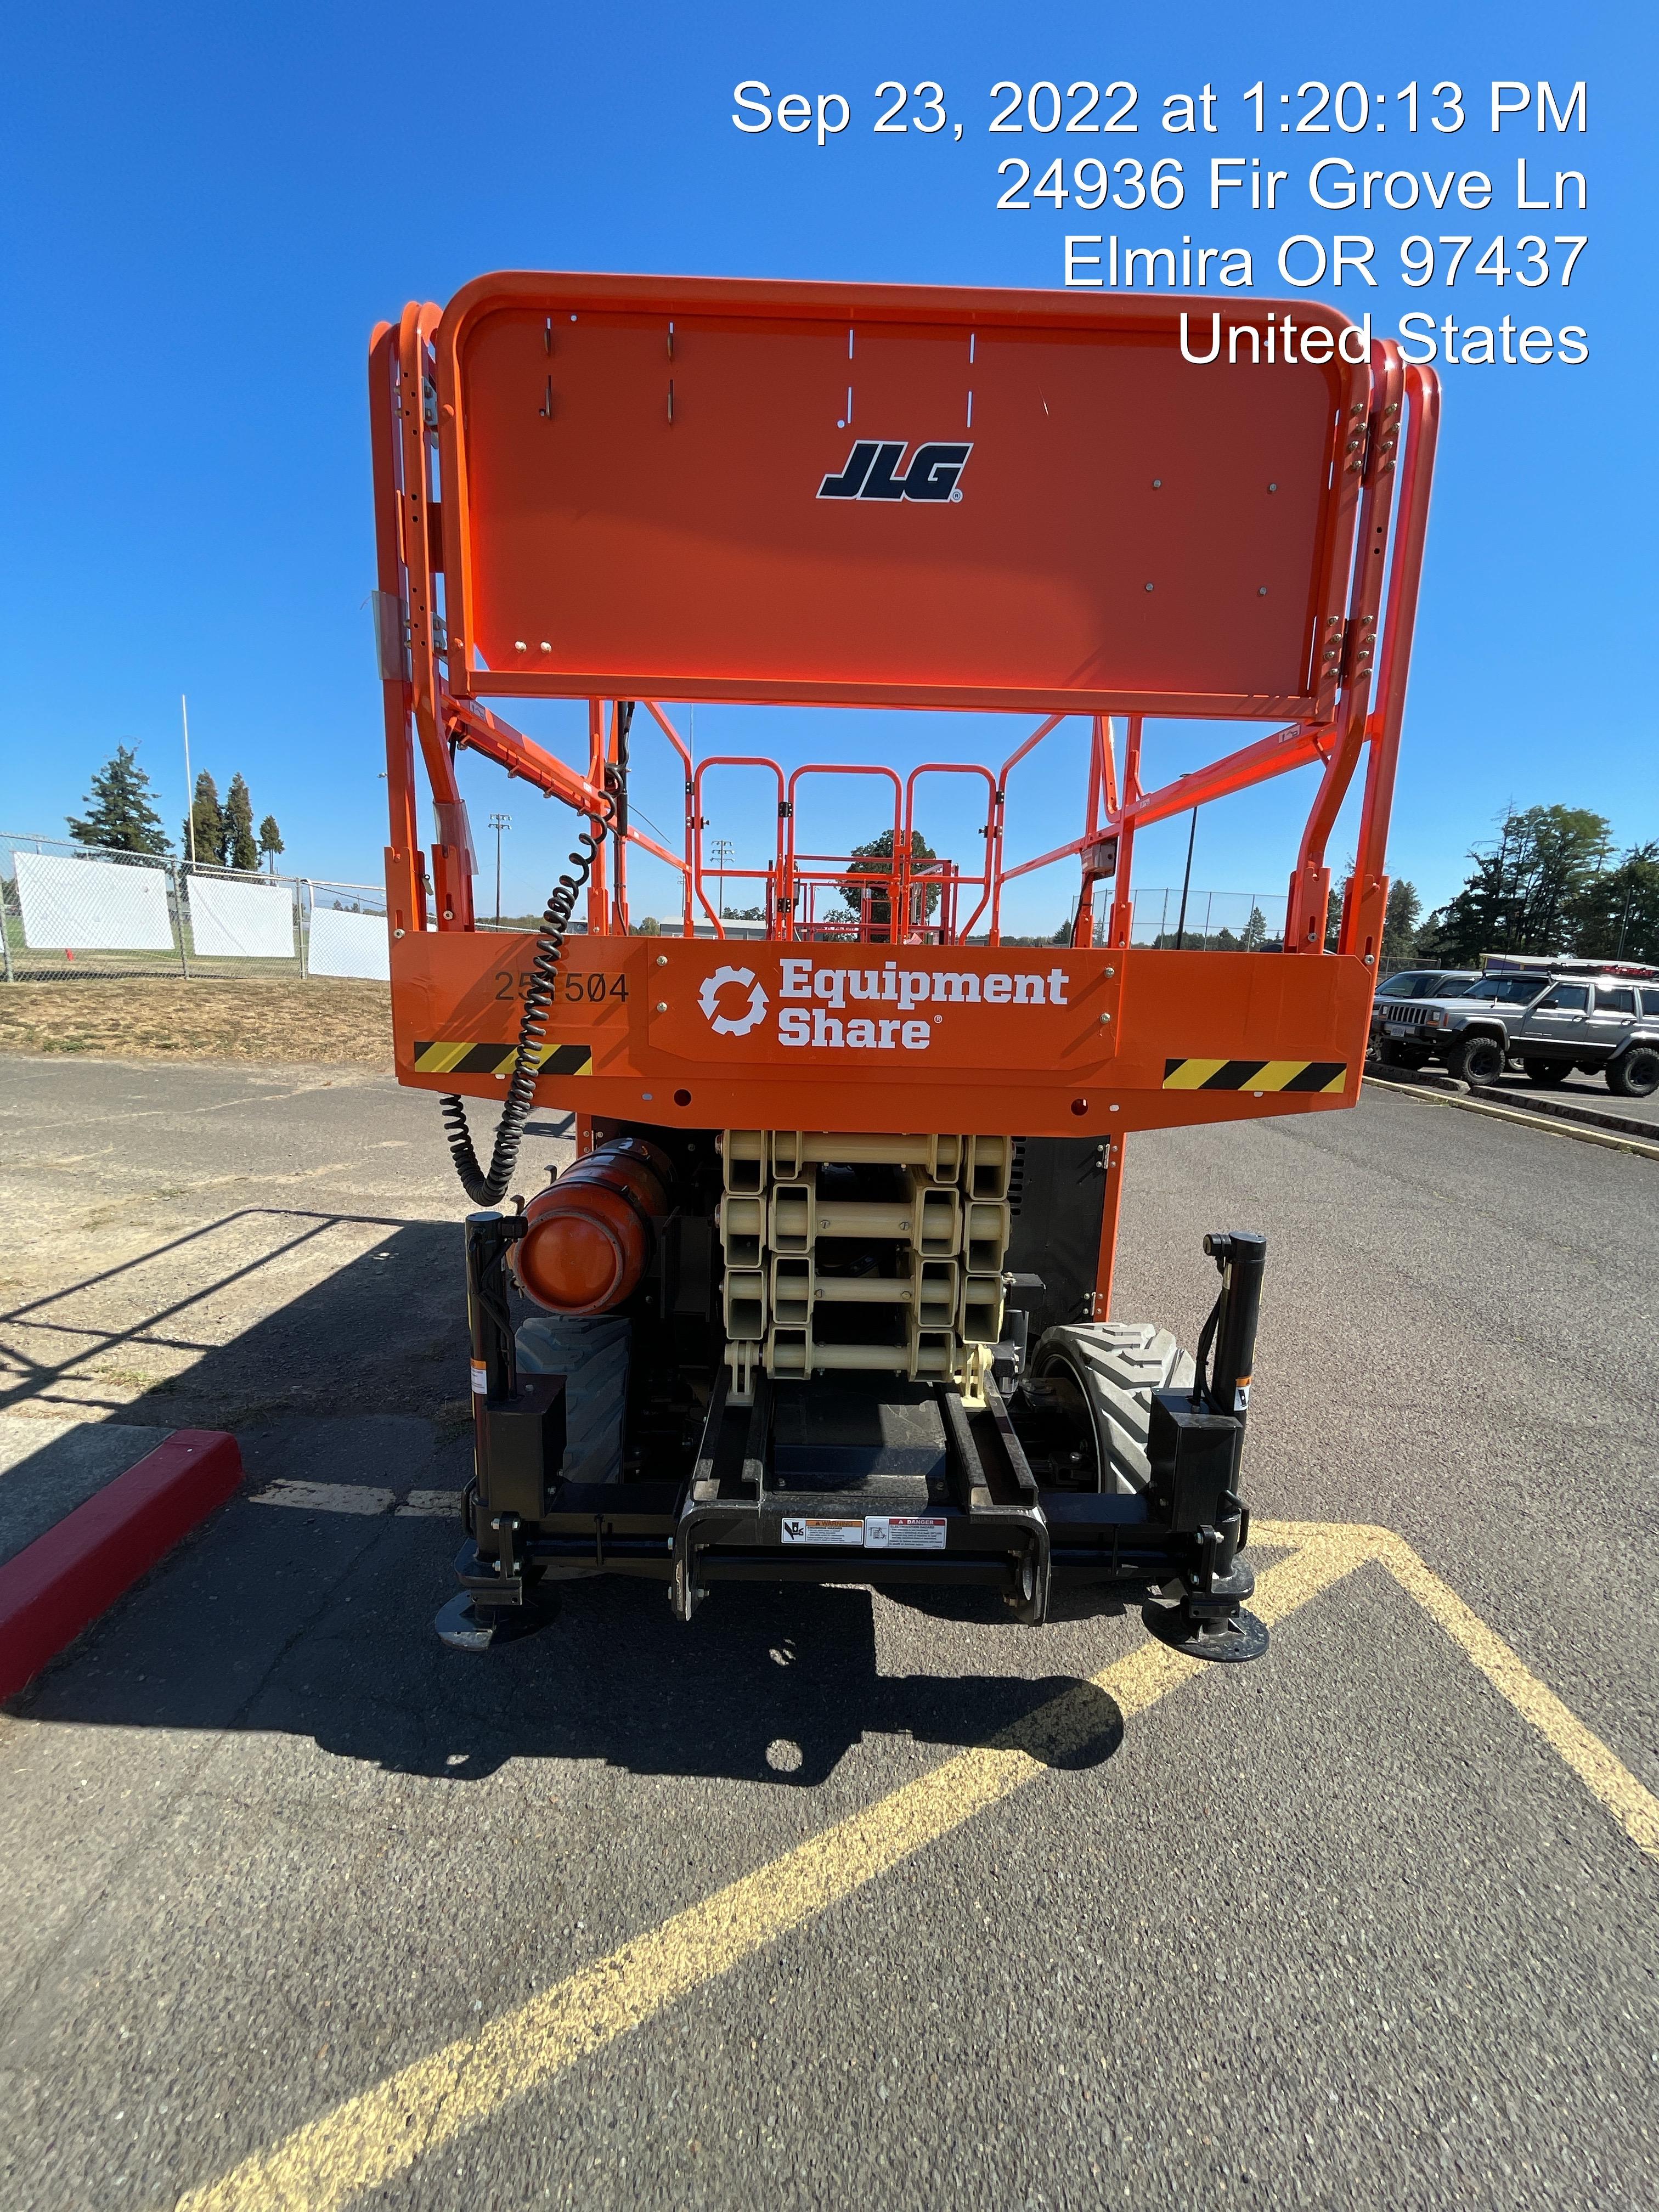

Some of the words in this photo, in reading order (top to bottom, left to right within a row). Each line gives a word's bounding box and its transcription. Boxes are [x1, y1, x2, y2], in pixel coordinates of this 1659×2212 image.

[816, 439, 974, 503] JLG
[779, 958, 1069, 1010] Equipment
[778, 1008, 931, 1049] Share
